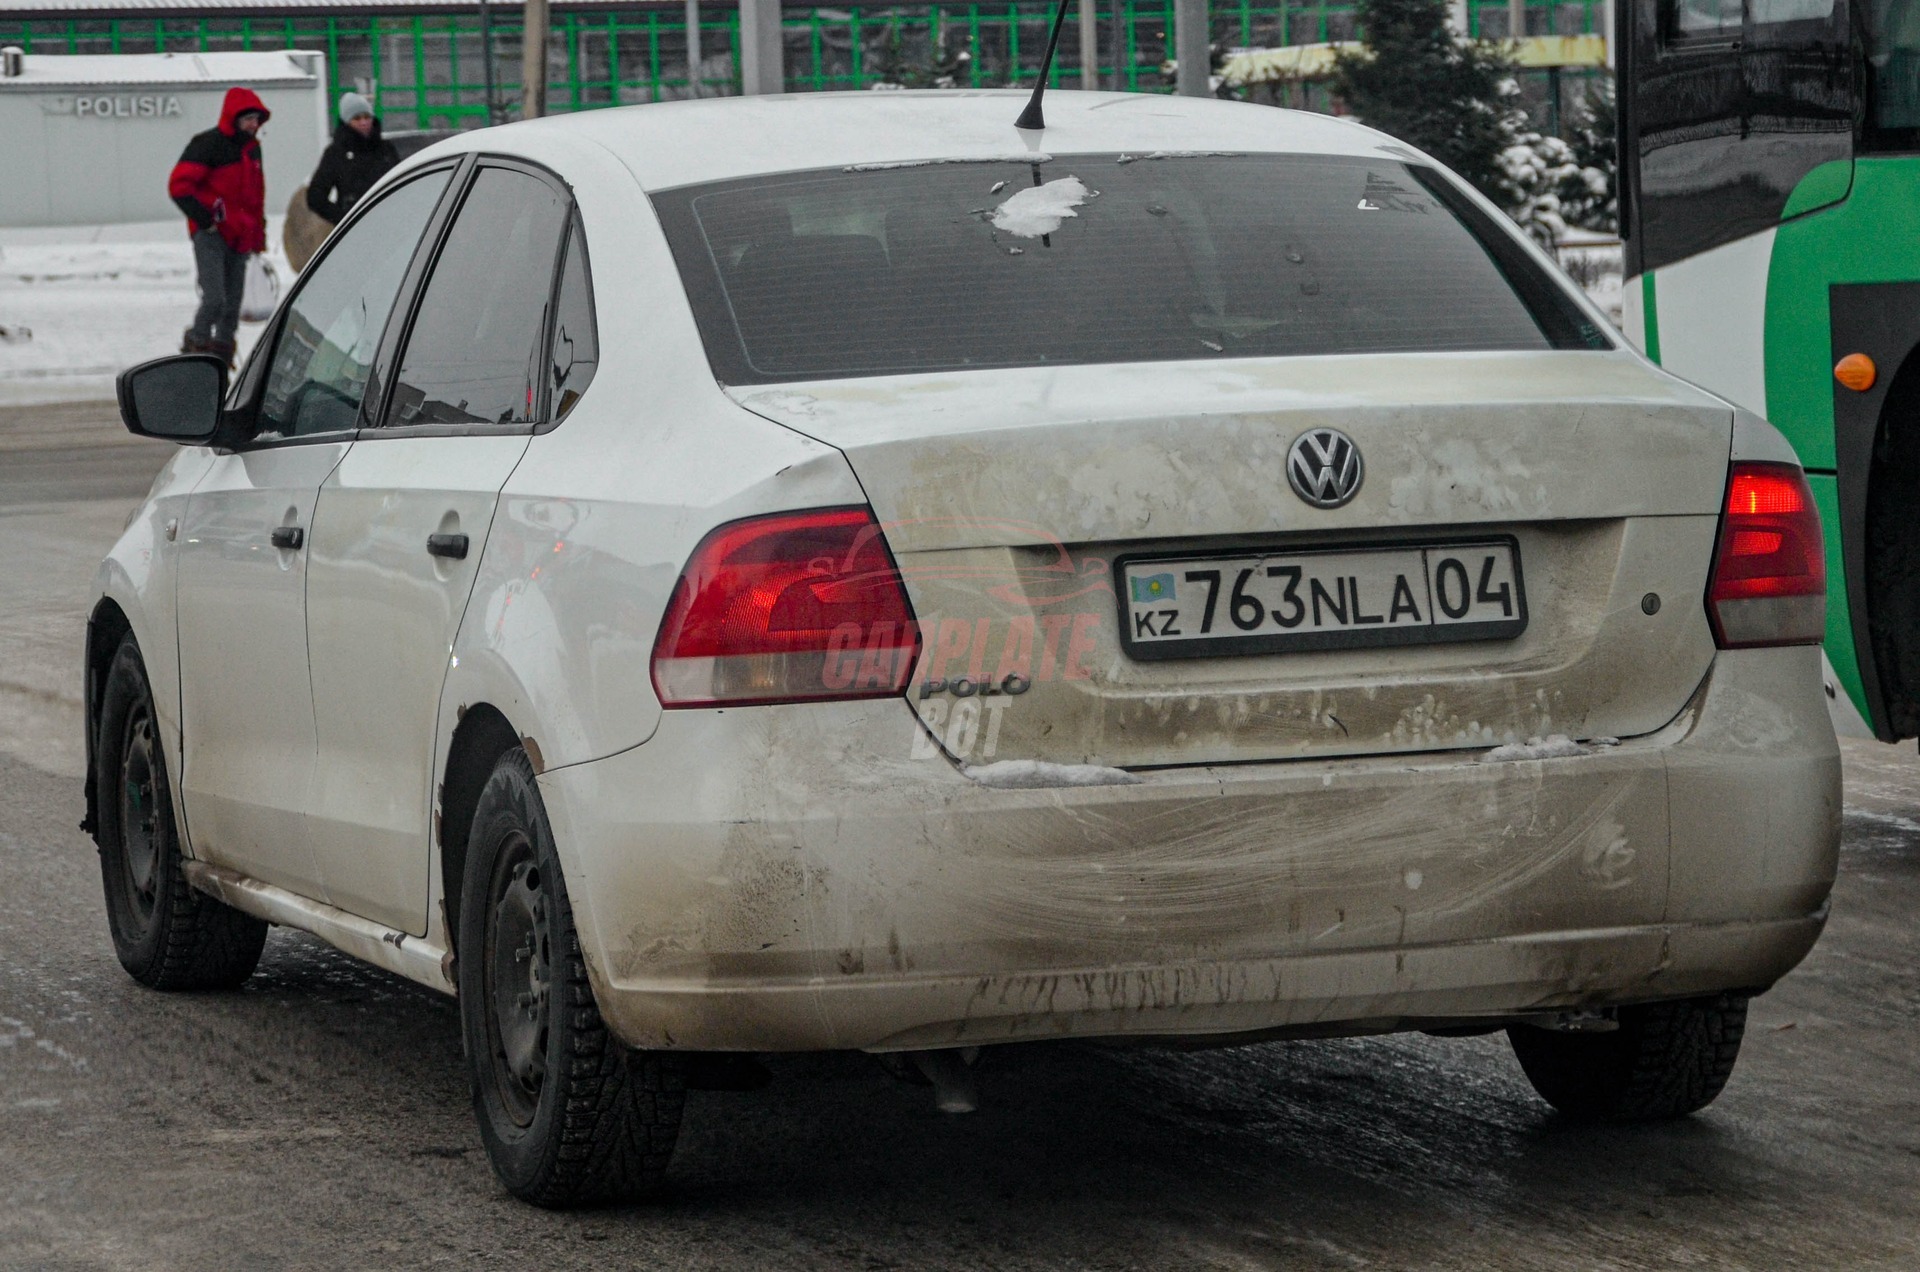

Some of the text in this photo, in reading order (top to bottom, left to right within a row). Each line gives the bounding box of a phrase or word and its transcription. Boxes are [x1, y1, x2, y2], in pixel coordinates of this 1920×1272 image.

[76, 96, 182, 117] POLISIA
[1436, 556, 1513, 619] 04
[1134, 609, 1181, 637] KZ
[919, 672, 1031, 699] POLO
